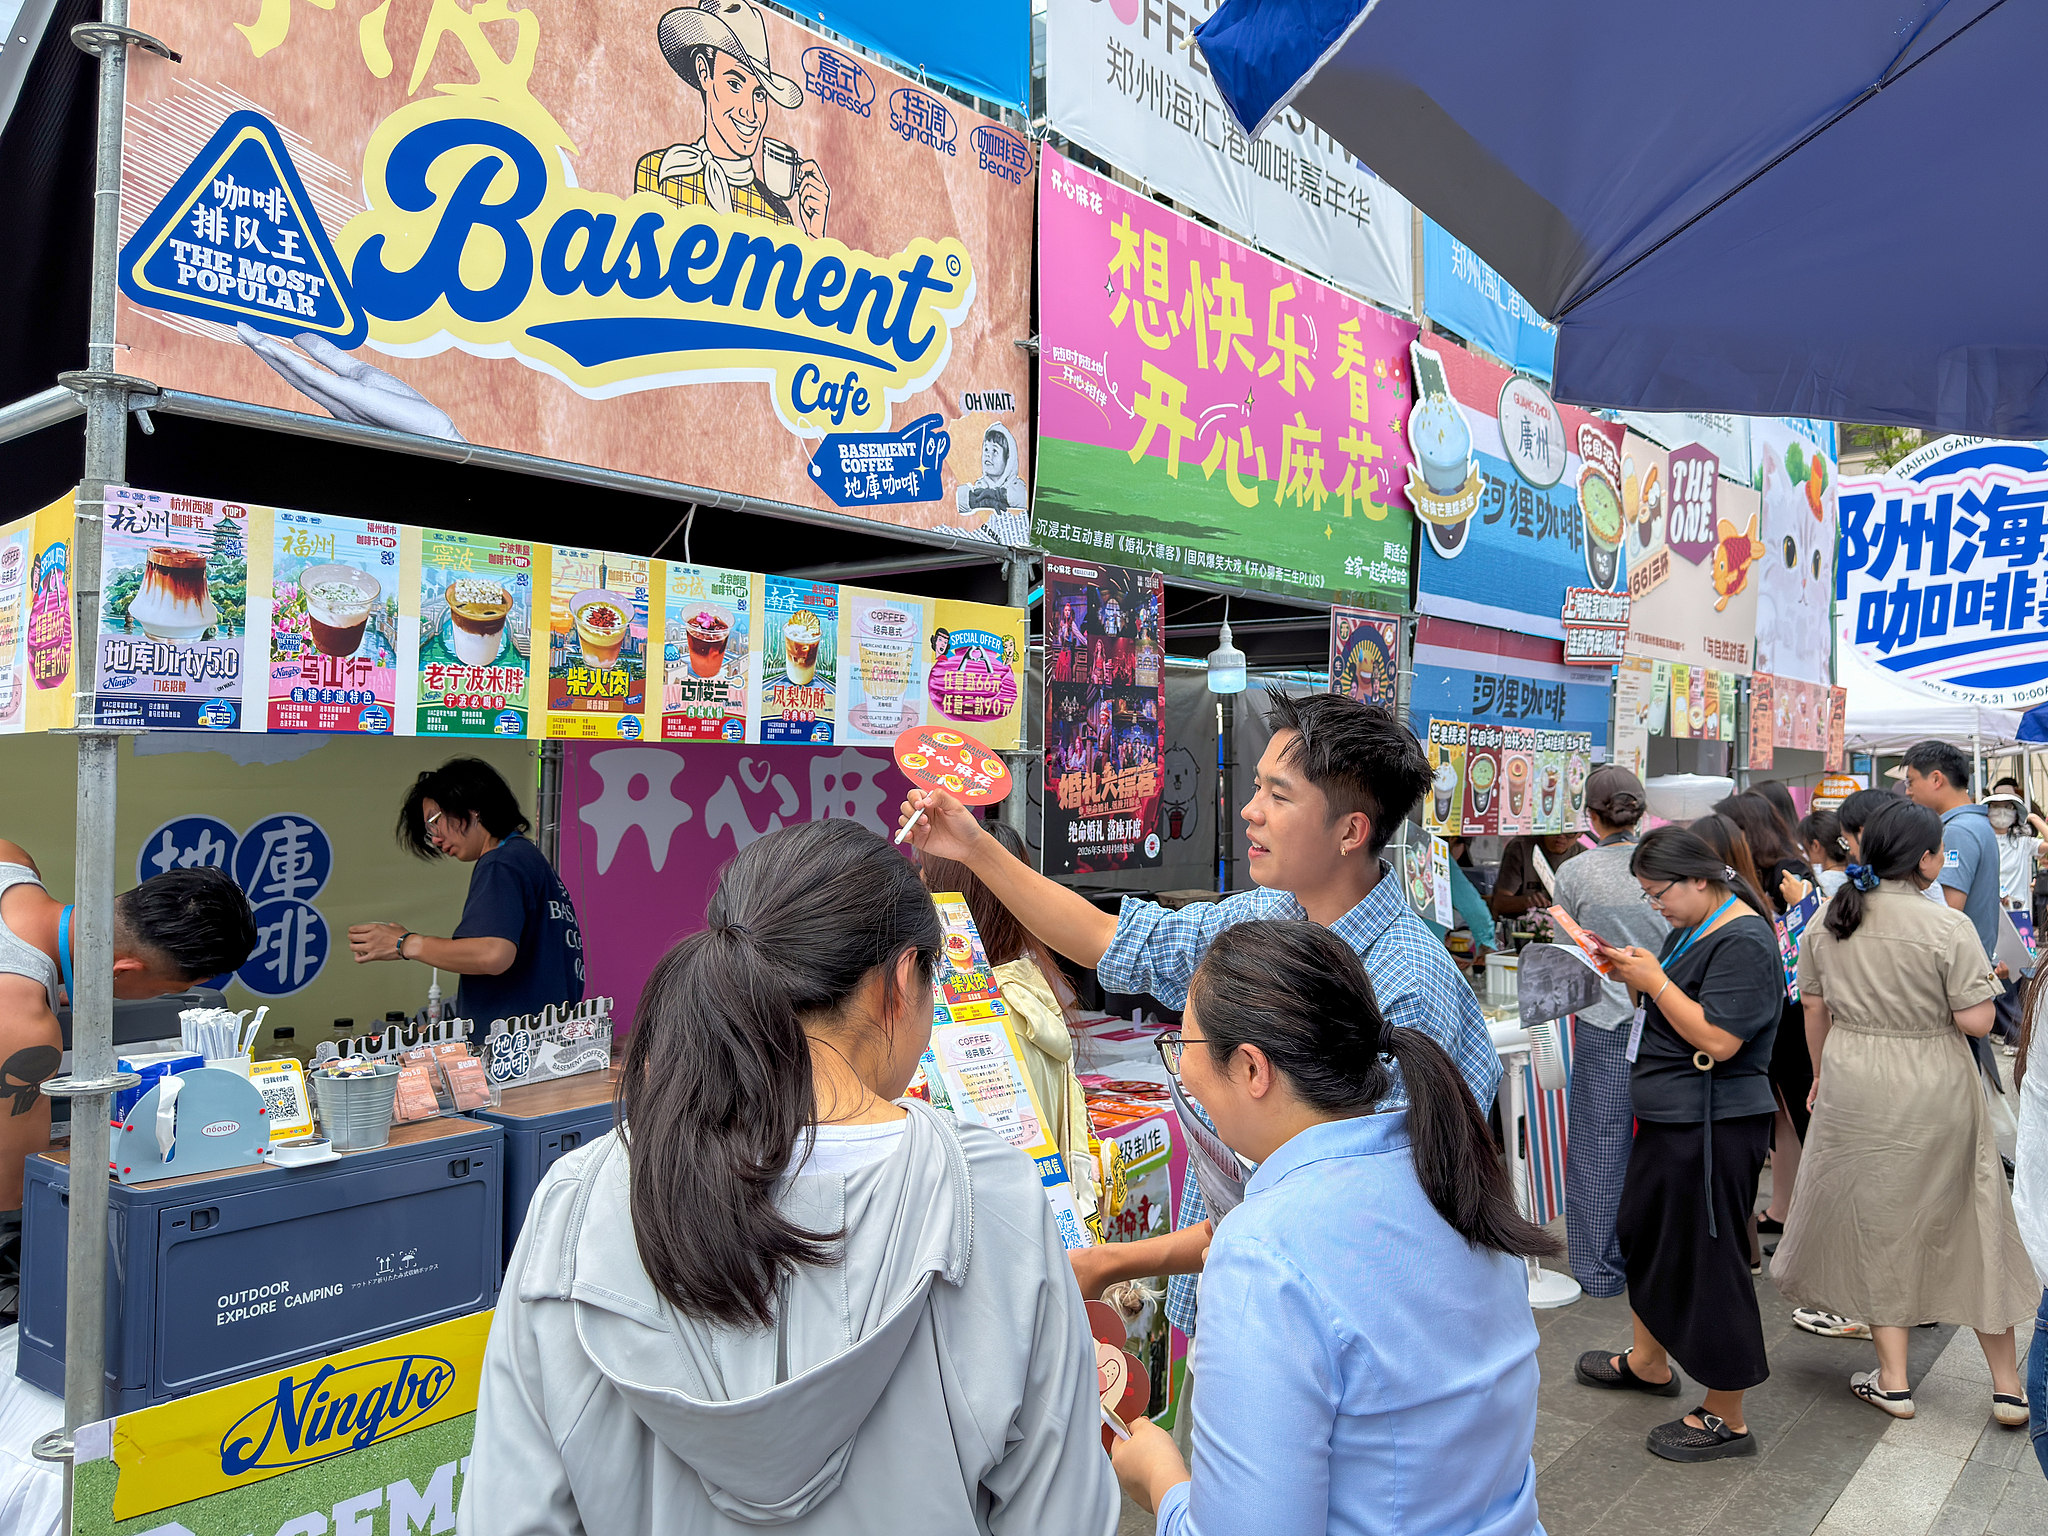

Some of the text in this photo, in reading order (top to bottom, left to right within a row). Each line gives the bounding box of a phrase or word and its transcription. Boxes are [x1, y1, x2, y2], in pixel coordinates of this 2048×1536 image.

[817, 50, 861, 98] 意式
[805, 74, 870, 118] Espresso
[902, 90, 946, 136] 特调
[890, 112, 957, 156] Signature
[977, 128, 1027, 170] 咖啡豆
[979, 152, 1021, 185] Beans
[213, 174, 288, 223] 咖啡
[1050, 169, 1103, 215] 开心麻花
[191, 203, 306, 265] 排队王
[352, 118, 954, 362] Basement
[169, 238, 325, 297] THE MOST
[177, 262, 317, 317] POPULAR
[1052, 346, 1104, 377] 随时随地
[791, 363, 870, 425] Cafe
[965, 393, 1015, 412] OH WAIT,
[1062, 366, 1108, 407] 开心相伴
[838, 419, 947, 470] BASEMENT Top
[1127, 360, 1388, 521] 开心麻花
[1519, 415, 1550, 468] 廣州
[841, 457, 895, 473] COFFEE
[1896, 447, 1940, 479] HAIHUI
[844, 472, 920, 500] 地庫咖啡
[1673, 458, 1715, 502] THE
[109, 505, 170, 538] 杭州
[170, 497, 213, 515] 杭州西湖
[171, 513, 204, 529] 咖啡节
[225, 506, 242, 518] TOP1
[1481, 471, 1583, 554] 河狸咖啡
[282, 527, 335, 561] 福州
[555, 558, 597, 590] 广州
[871, 611, 906, 622] COFFEE
[1855, 570, 2048, 654] 咖啡
[951, 632, 1001, 650] SPECIAL OFFER
[104, 640, 239, 682] 地库Dirty5.0
[153, 680, 187, 693] 门店招牌
[425, 663, 525, 694] 老宁波米胖
[566, 667, 630, 698] 柴火肉
[681, 679, 729, 703] 古楼兰
[293, 688, 373, 706] 福建非遗特色
[772, 685, 826, 709] 凤梨奶酥
[942, 694, 1012, 716] 任意三款90元
[1472, 674, 1566, 722] 河狸咖啡
[964, 743, 991, 760] MAHUA
[1470, 730, 1503, 749] 花园派对
[1504, 730, 1534, 751] 柏林少女
[917, 743, 994, 787] 开心麻花
[1068, 818, 1141, 843] 绝命婚礼 落座开席
[949, 973, 988, 994] 柴火肉
[958, 1034, 992, 1047] COFFEE
[552, 1049, 605, 1072] BASEMENT COFFEE
[216, 1283, 344, 1326] EXPLORE CAMPING
[217, 1280, 290, 1309] OUTDOOR
[222, 1363, 447, 1476] Ningbo
